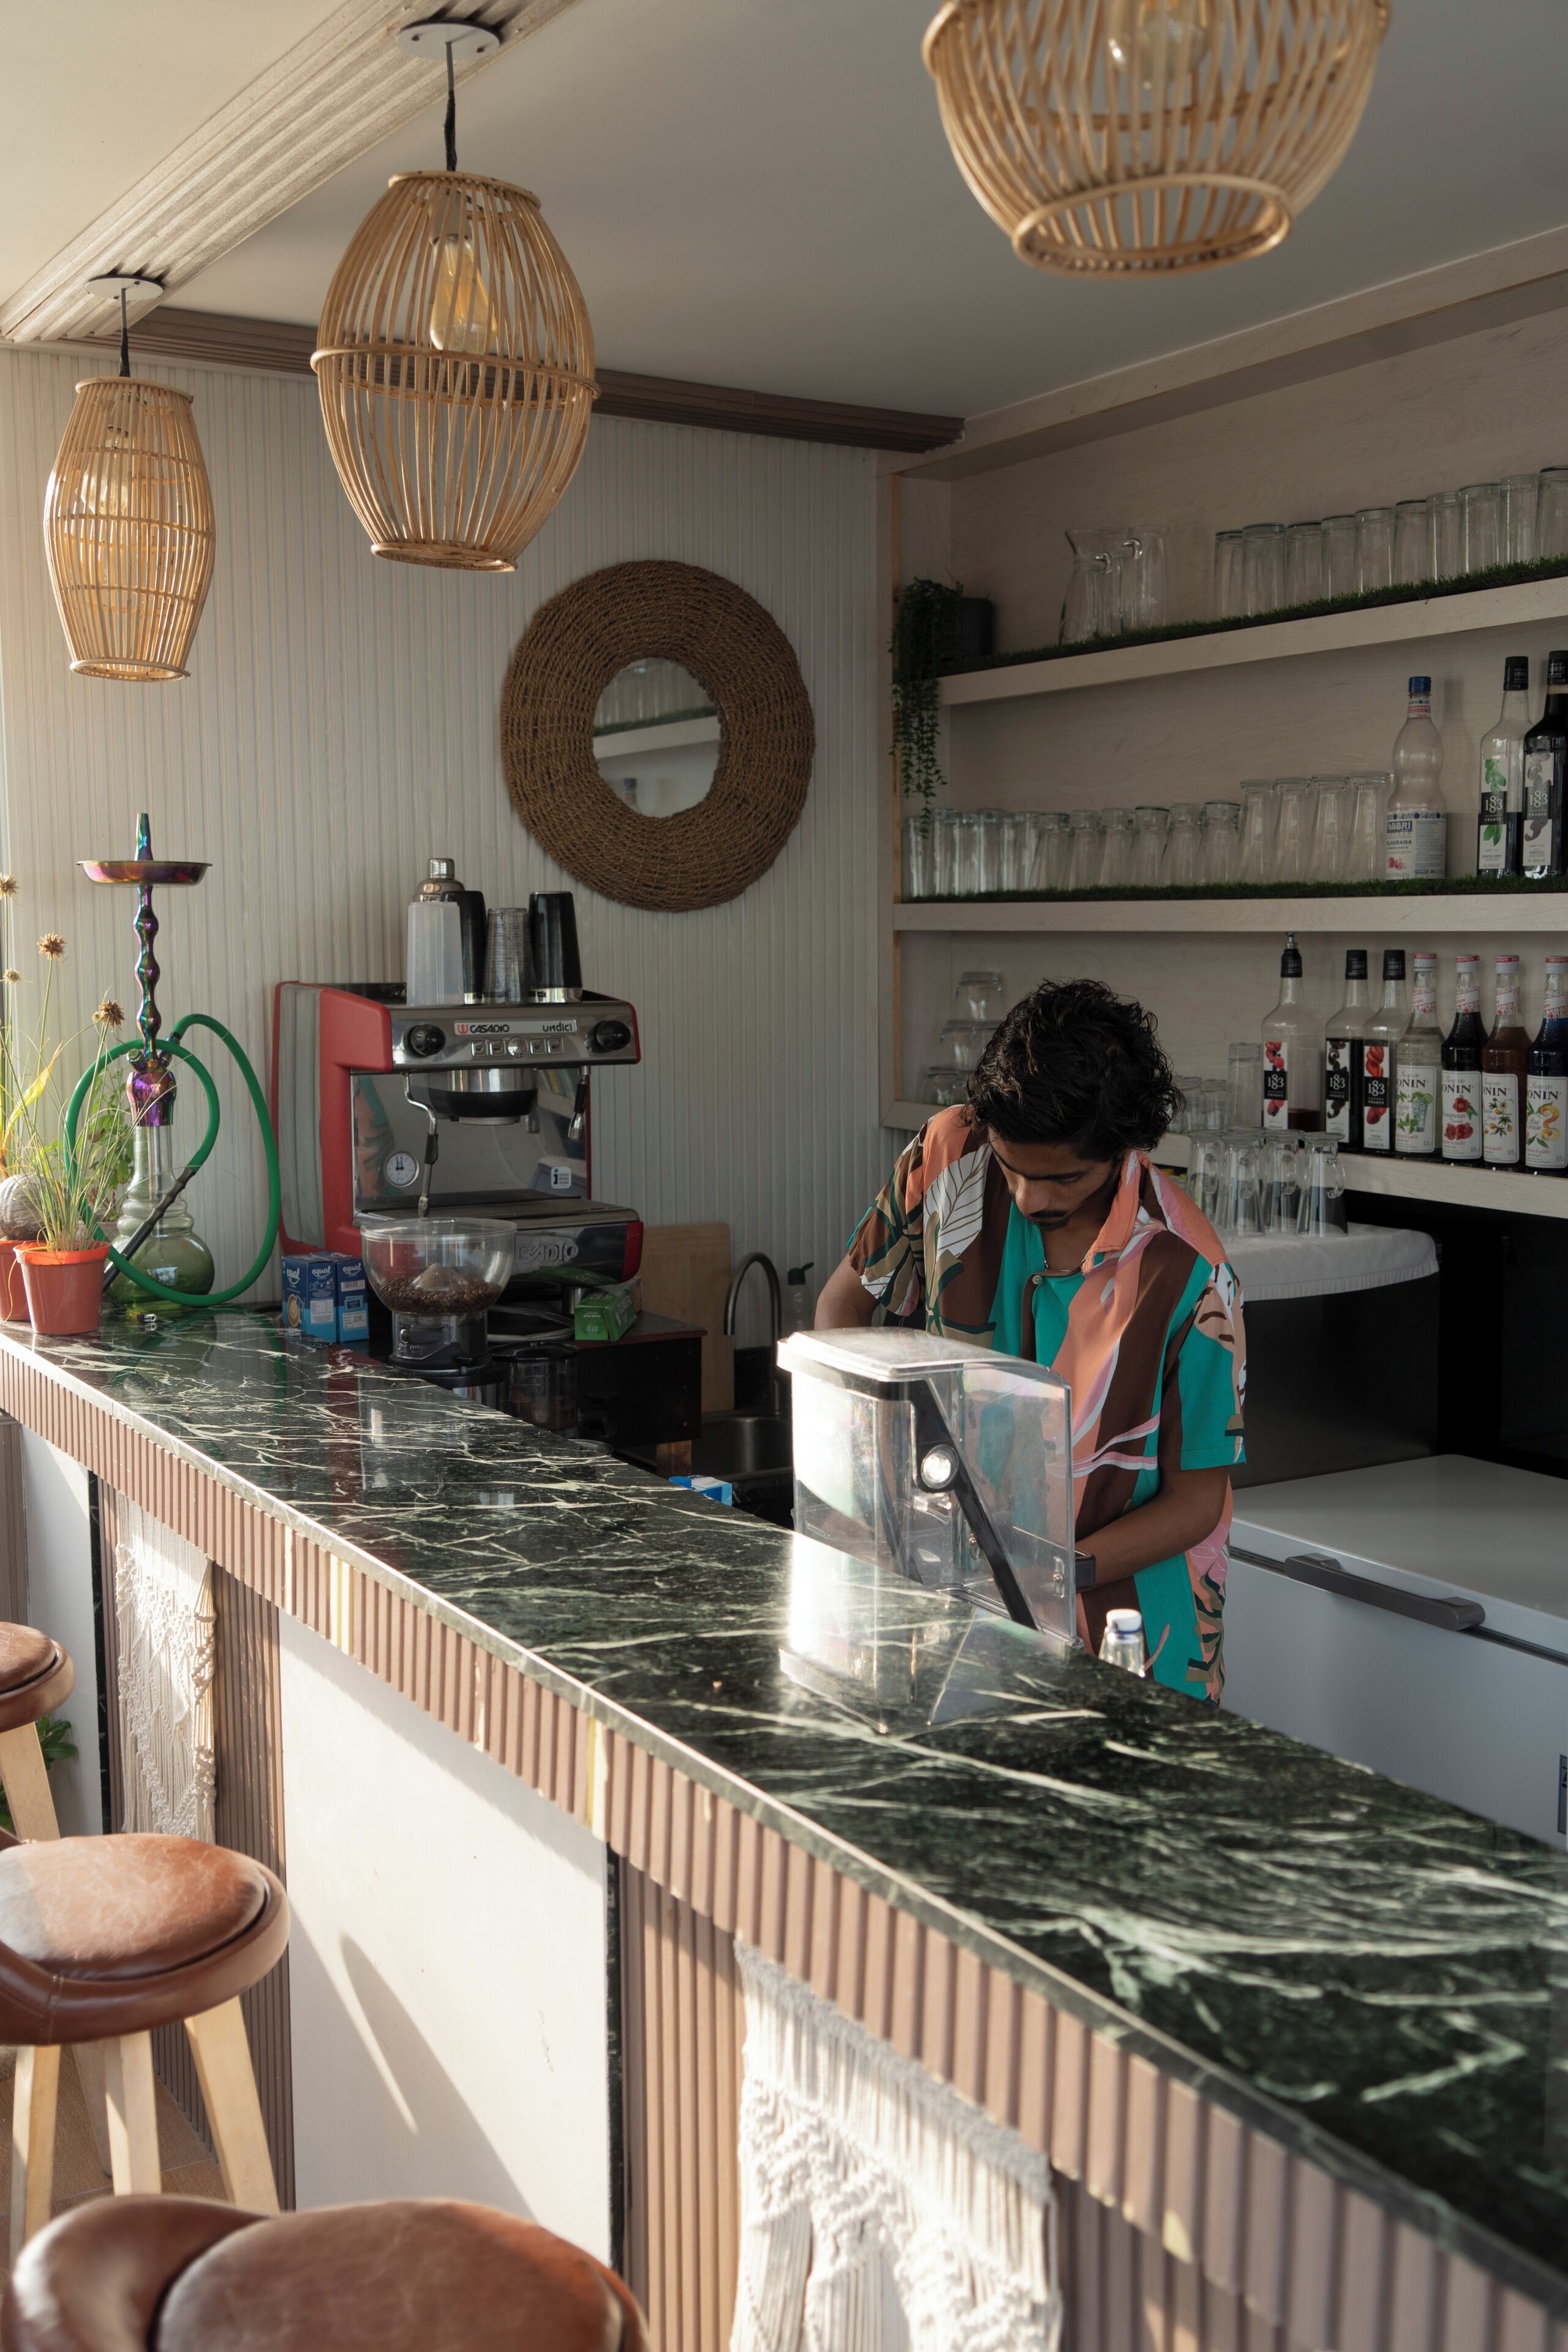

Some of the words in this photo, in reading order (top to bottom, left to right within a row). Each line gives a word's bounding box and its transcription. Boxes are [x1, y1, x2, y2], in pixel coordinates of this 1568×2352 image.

[1485, 796, 1503, 813] 1883
[1530, 790, 1548, 808] 1883
[470, 1024, 510, 1033] CASADIO
[543, 1022, 572, 1032] undici
[1267, 1074, 1284, 1090] 1883
[1330, 1074, 1345, 1090] 1883
[1397, 1079, 1426, 1088] ONIN
[1368, 1080, 1385, 1096] 1883
[1443, 1085, 1471, 1093] ONIN
[1528, 1090, 1559, 1100] ONIN
[312, 1265, 331, 1276] equal
[343, 1263, 362, 1273] equal
[287, 1268, 300, 1280] equal
